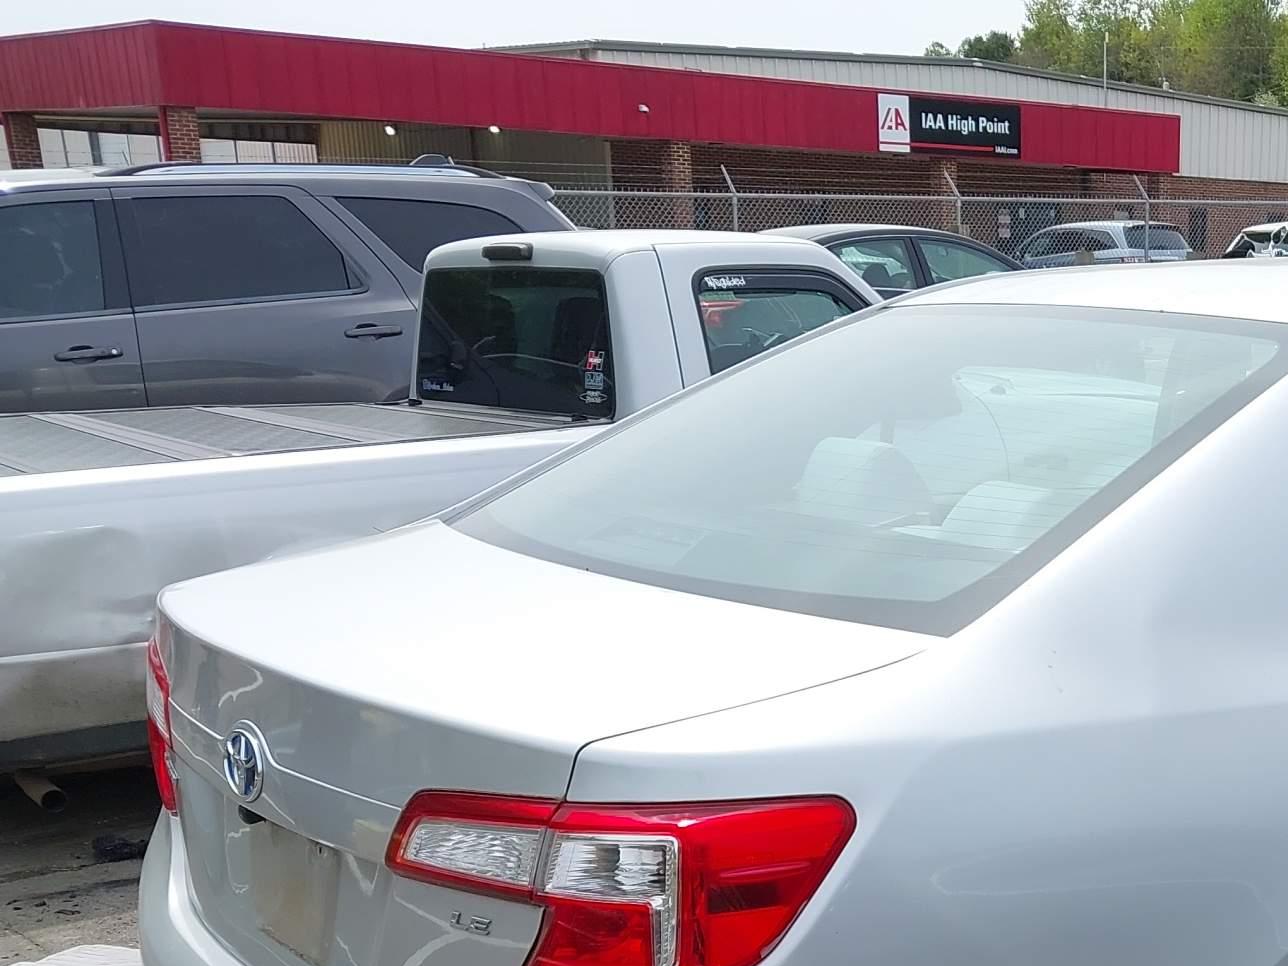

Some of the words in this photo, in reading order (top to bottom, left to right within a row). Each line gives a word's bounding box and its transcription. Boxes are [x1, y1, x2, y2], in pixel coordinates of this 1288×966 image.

[921, 112, 945, 130] IAA
[948, 114, 976, 135] High
[979, 117, 1010, 135] Point
[450, 911, 492, 935] LE
